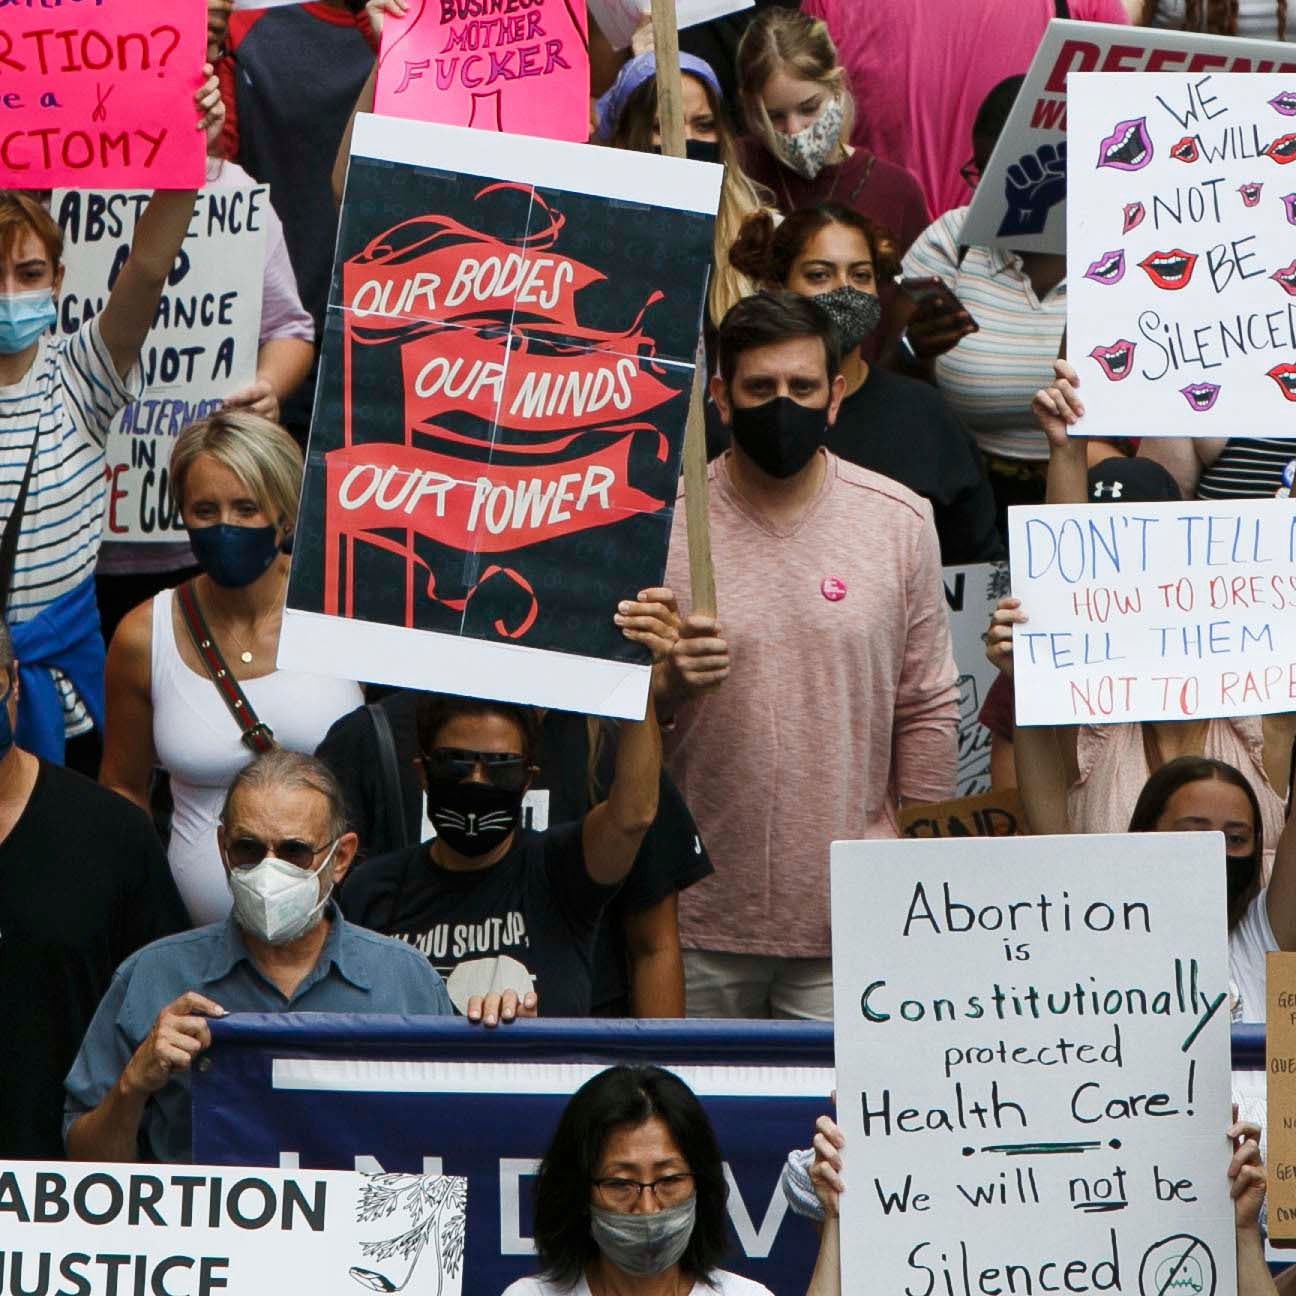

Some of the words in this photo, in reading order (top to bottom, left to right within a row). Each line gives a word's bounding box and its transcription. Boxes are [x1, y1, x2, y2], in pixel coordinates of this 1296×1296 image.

[40, 90, 59, 109] a
[1156, 75, 1228, 129] WE
[1199, 124, 1272, 165] WILL
[1152, 178, 1227, 232] NOT
[351, 270, 443, 317] OUR
[443, 252, 575, 310] BODIES
[1205, 235, 1267, 294] BE
[414, 356, 507, 403] OUR
[509, 359, 637, 419] MINDS
[338, 462, 461, 519] OUR
[466, 464, 617, 535] POWER
[1026, 515, 1160, 582] DON'T
[1177, 515, 1268, 567] TELL
[1072, 586, 1145, 623] HOW
[1158, 582, 1195, 611] TO
[1019, 631, 1128, 670] TELL
[1149, 622, 1272, 659] THEM
[902, 882, 1151, 937] Abortion
[1004, 939, 1030, 962] is
[874, 1174, 930, 1215] We
[956, 1165, 1040, 1207] will
[1070, 1165, 1128, 1204] not
[1153, 1158, 1198, 1203] be
